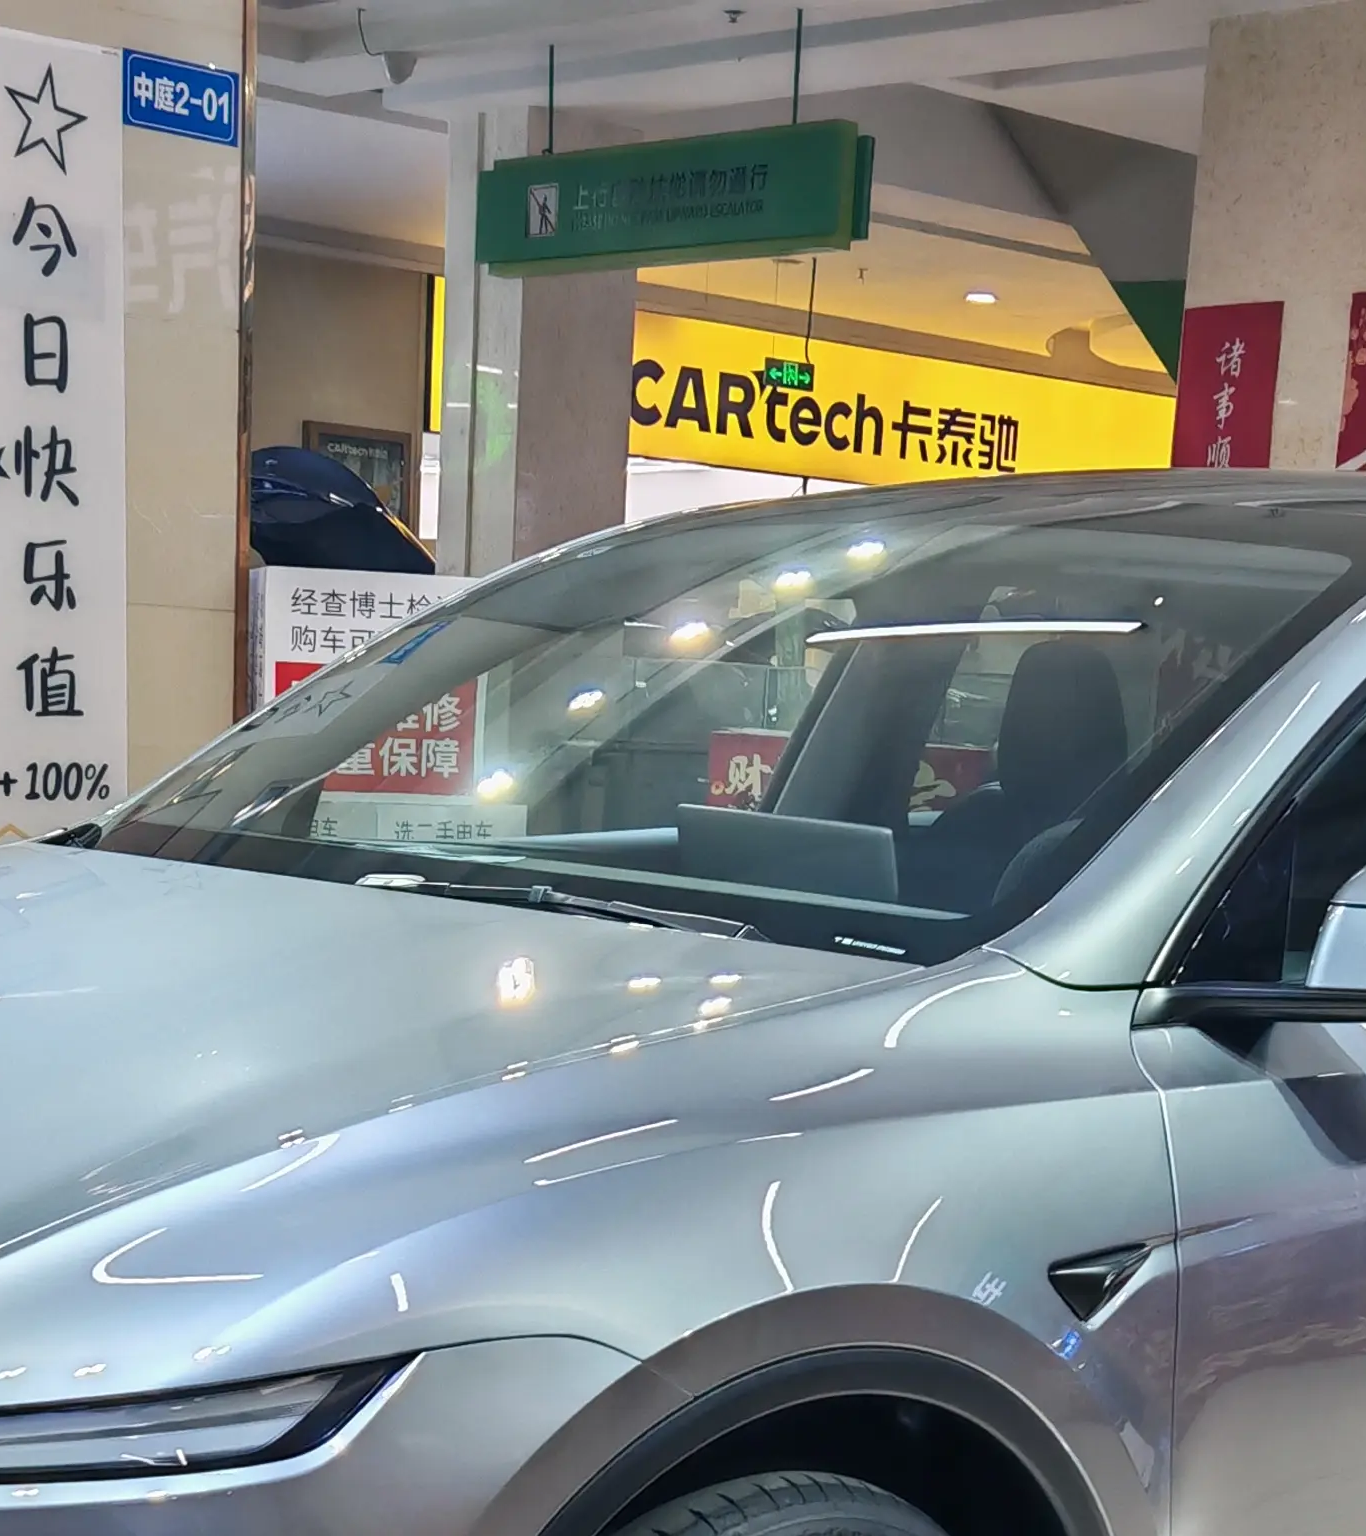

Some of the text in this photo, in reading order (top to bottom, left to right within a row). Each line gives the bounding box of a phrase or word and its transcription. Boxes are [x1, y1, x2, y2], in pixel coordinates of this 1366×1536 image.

[134, 71, 230, 125] 中庭2-01
[12, 195, 85, 718] 今日快乐值
[891, 400, 1019, 473] 卡泰驰
[290, 587, 448, 620] 经查博士检
